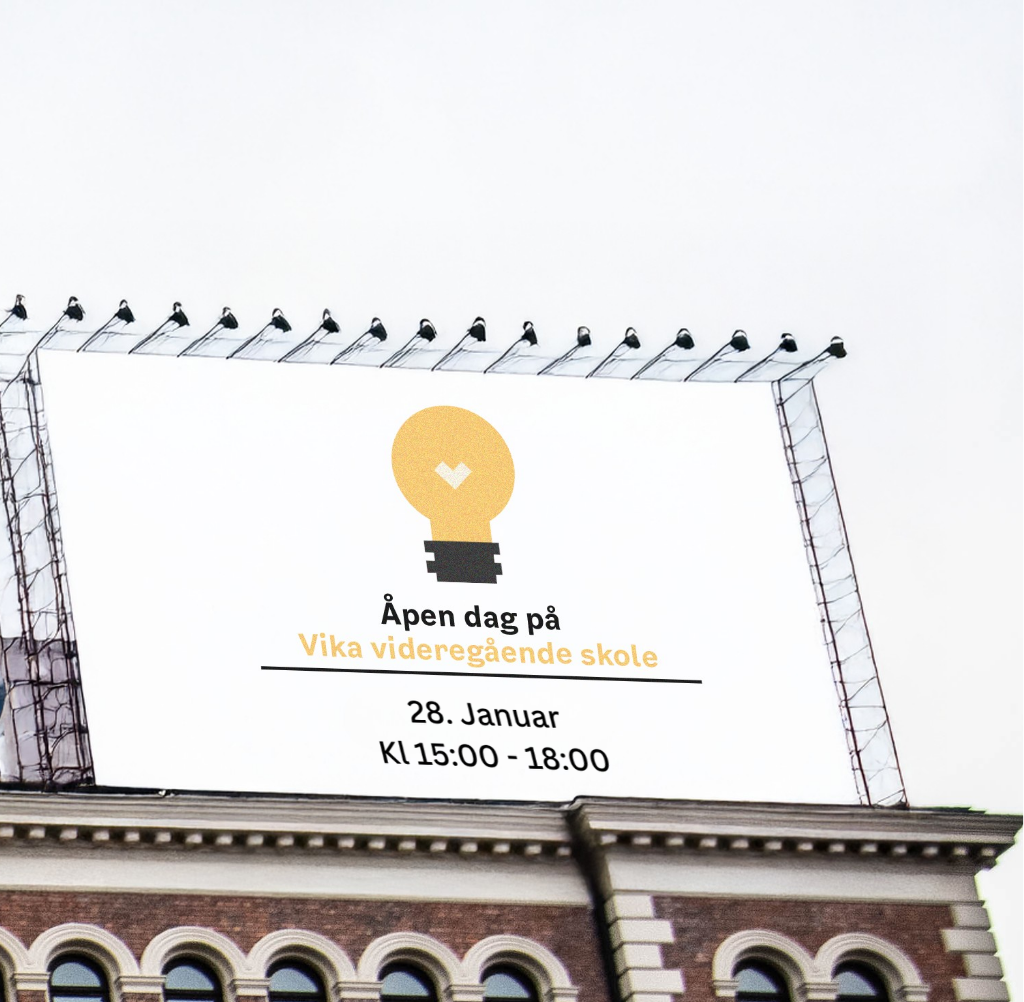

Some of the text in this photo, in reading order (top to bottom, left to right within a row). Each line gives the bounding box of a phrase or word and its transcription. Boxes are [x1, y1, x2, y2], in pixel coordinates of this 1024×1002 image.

[380, 593, 561, 636] Åpen dag på
[297, 632, 658, 669] Vika videregående skole
[407, 700, 560, 729] 28. Januar
[379, 740, 410, 765] Kl
[413, 742, 499, 768] 15:00
[524, 746, 610, 773] 18:00
